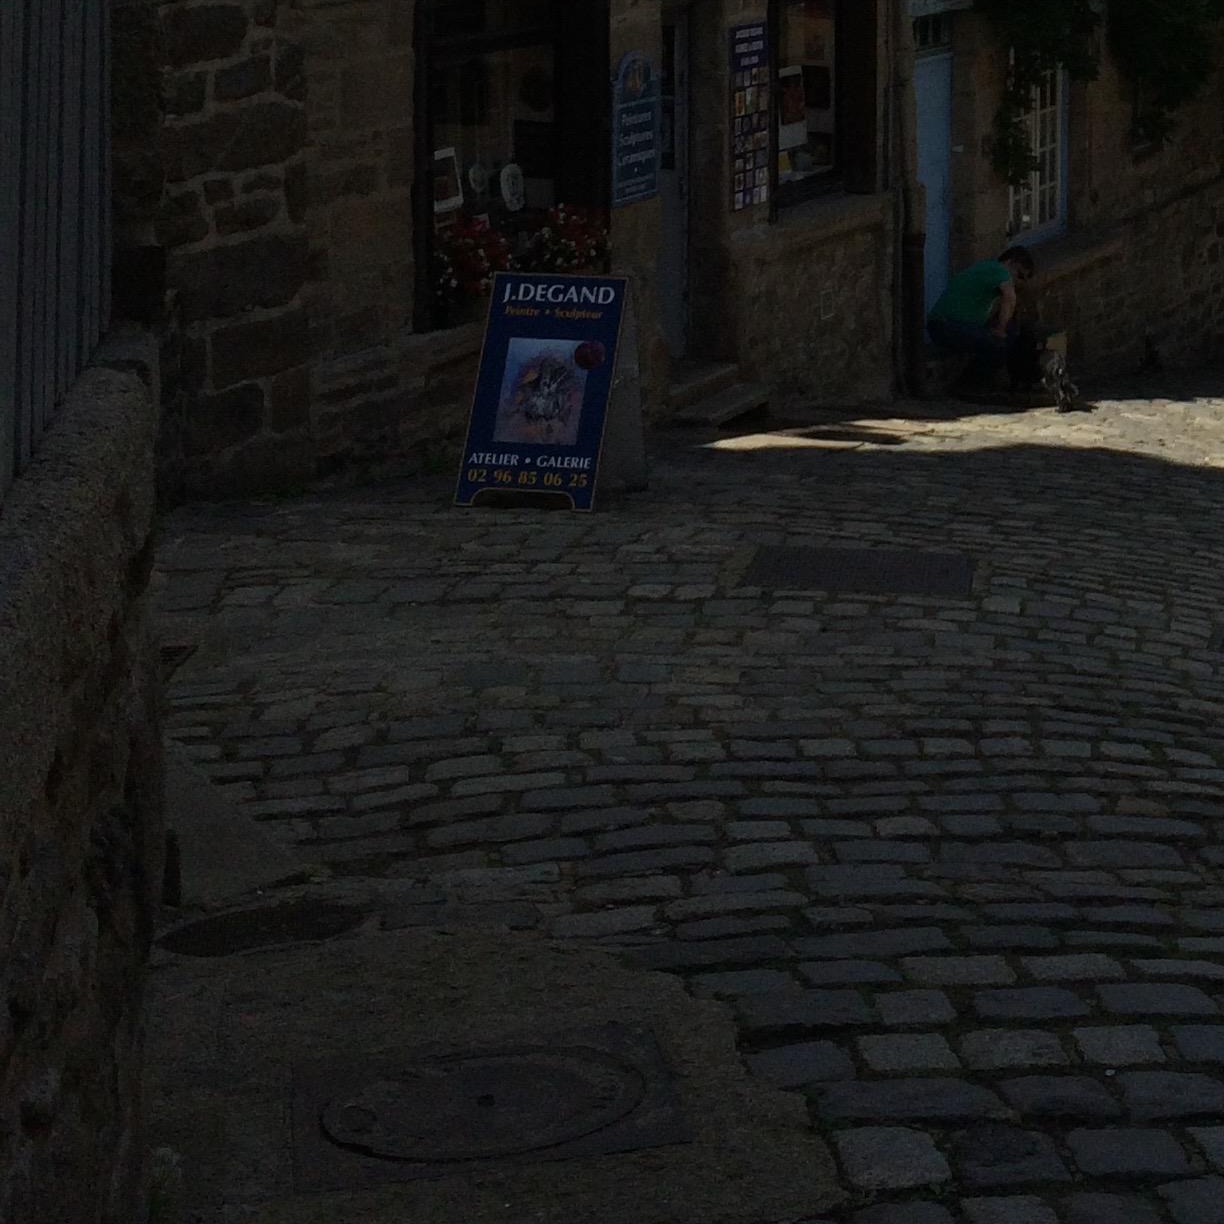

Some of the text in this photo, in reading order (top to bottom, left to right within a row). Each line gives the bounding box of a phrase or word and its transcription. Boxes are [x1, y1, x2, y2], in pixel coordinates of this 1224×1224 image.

[503, 283, 615, 305] J.DEGAND
[468, 452, 592, 469] ATELIER GALERIE
[468, 468, 487, 482] 02
[543, 471, 563, 486] 06
[568, 473, 588, 487] 25
